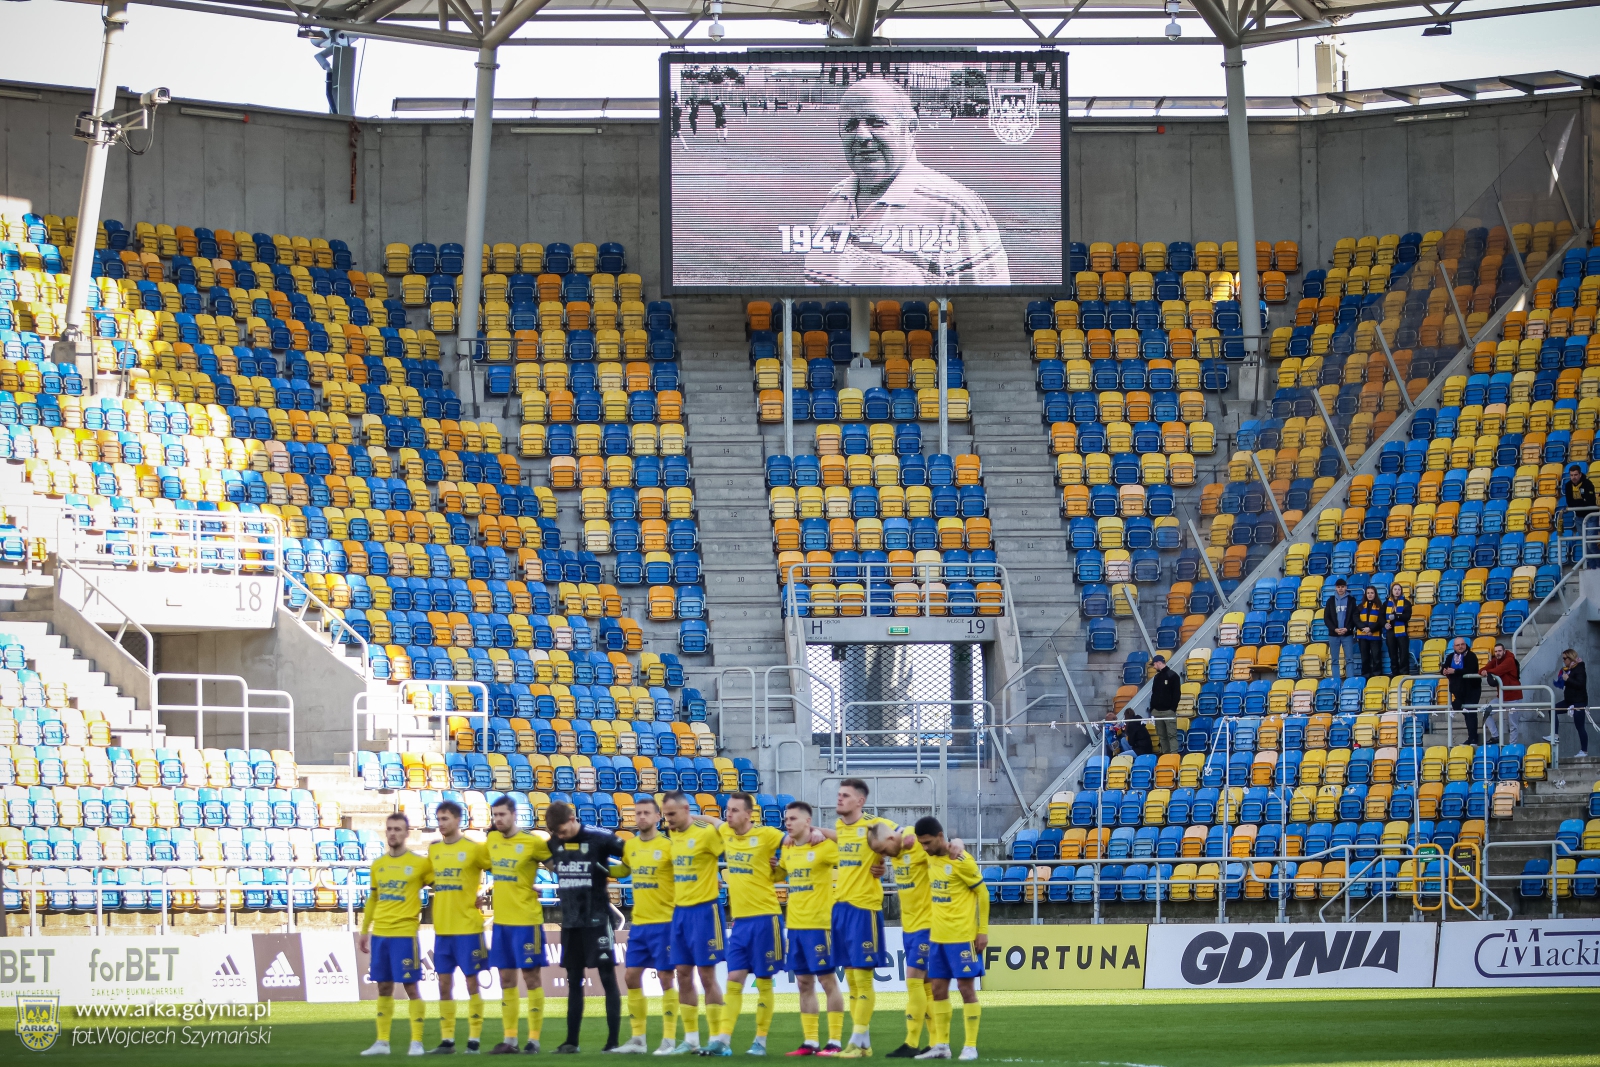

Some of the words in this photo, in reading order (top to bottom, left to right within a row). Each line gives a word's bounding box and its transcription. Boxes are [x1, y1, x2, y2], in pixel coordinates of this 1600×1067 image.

[778, 225, 851, 253] 1947
[881, 225, 960, 253] 2023
[235, 581, 262, 612] 18
[811, 620, 823, 635] H
[966, 619, 986, 634] 19
[558, 861, 592, 872] forBET
[984, 944, 1142, 970] FORTUNA
[1180, 930, 1401, 985] GDYNIA
[1496, 927, 1600, 968] Macki
[88, 947, 180, 982] forBET
[211, 977, 247, 988] adidas
[262, 974, 301, 988] adidas
[315, 975, 350, 986] adidas
